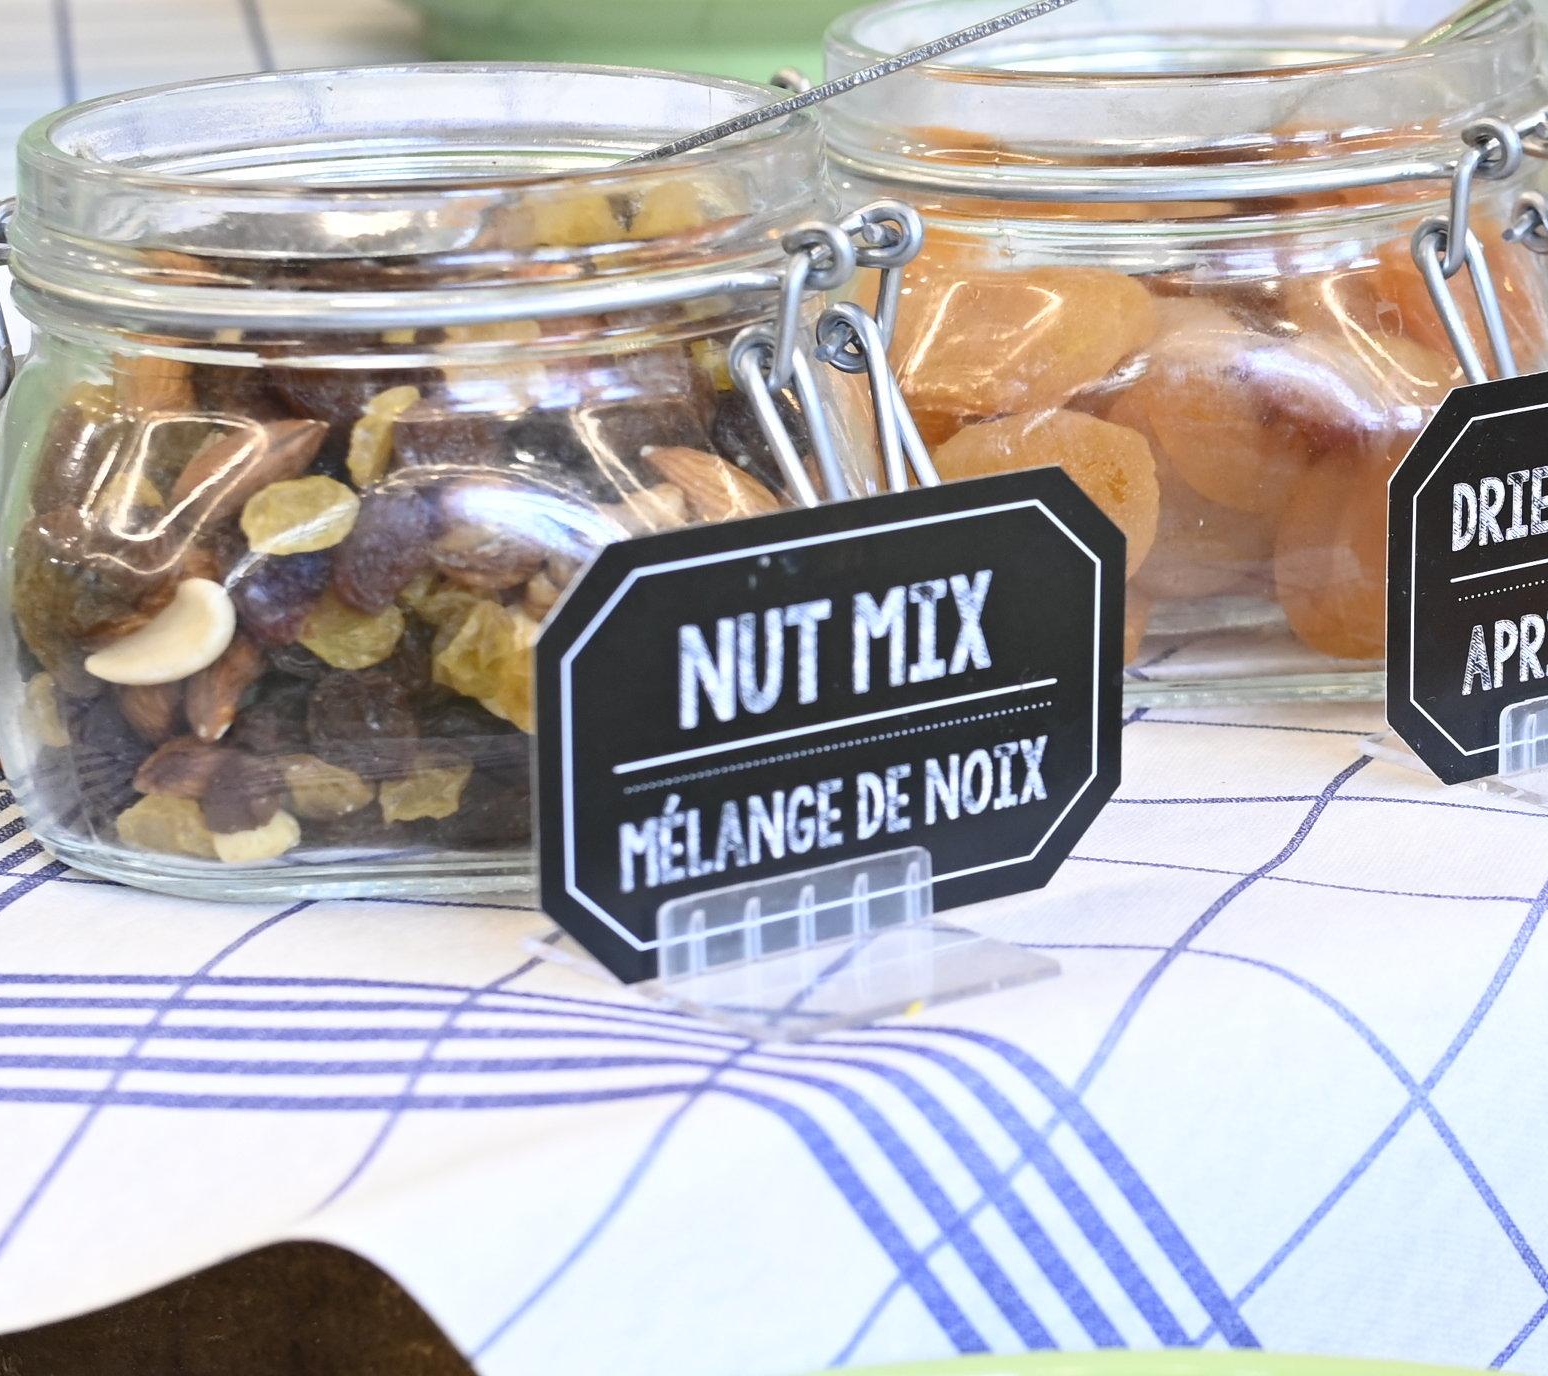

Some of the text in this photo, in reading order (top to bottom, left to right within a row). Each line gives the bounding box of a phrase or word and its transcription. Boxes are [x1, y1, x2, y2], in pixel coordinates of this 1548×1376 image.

[677, 569, 994, 731] NUT MIX
[617, 735, 1049, 894] MÉLANGE DE NOIX
